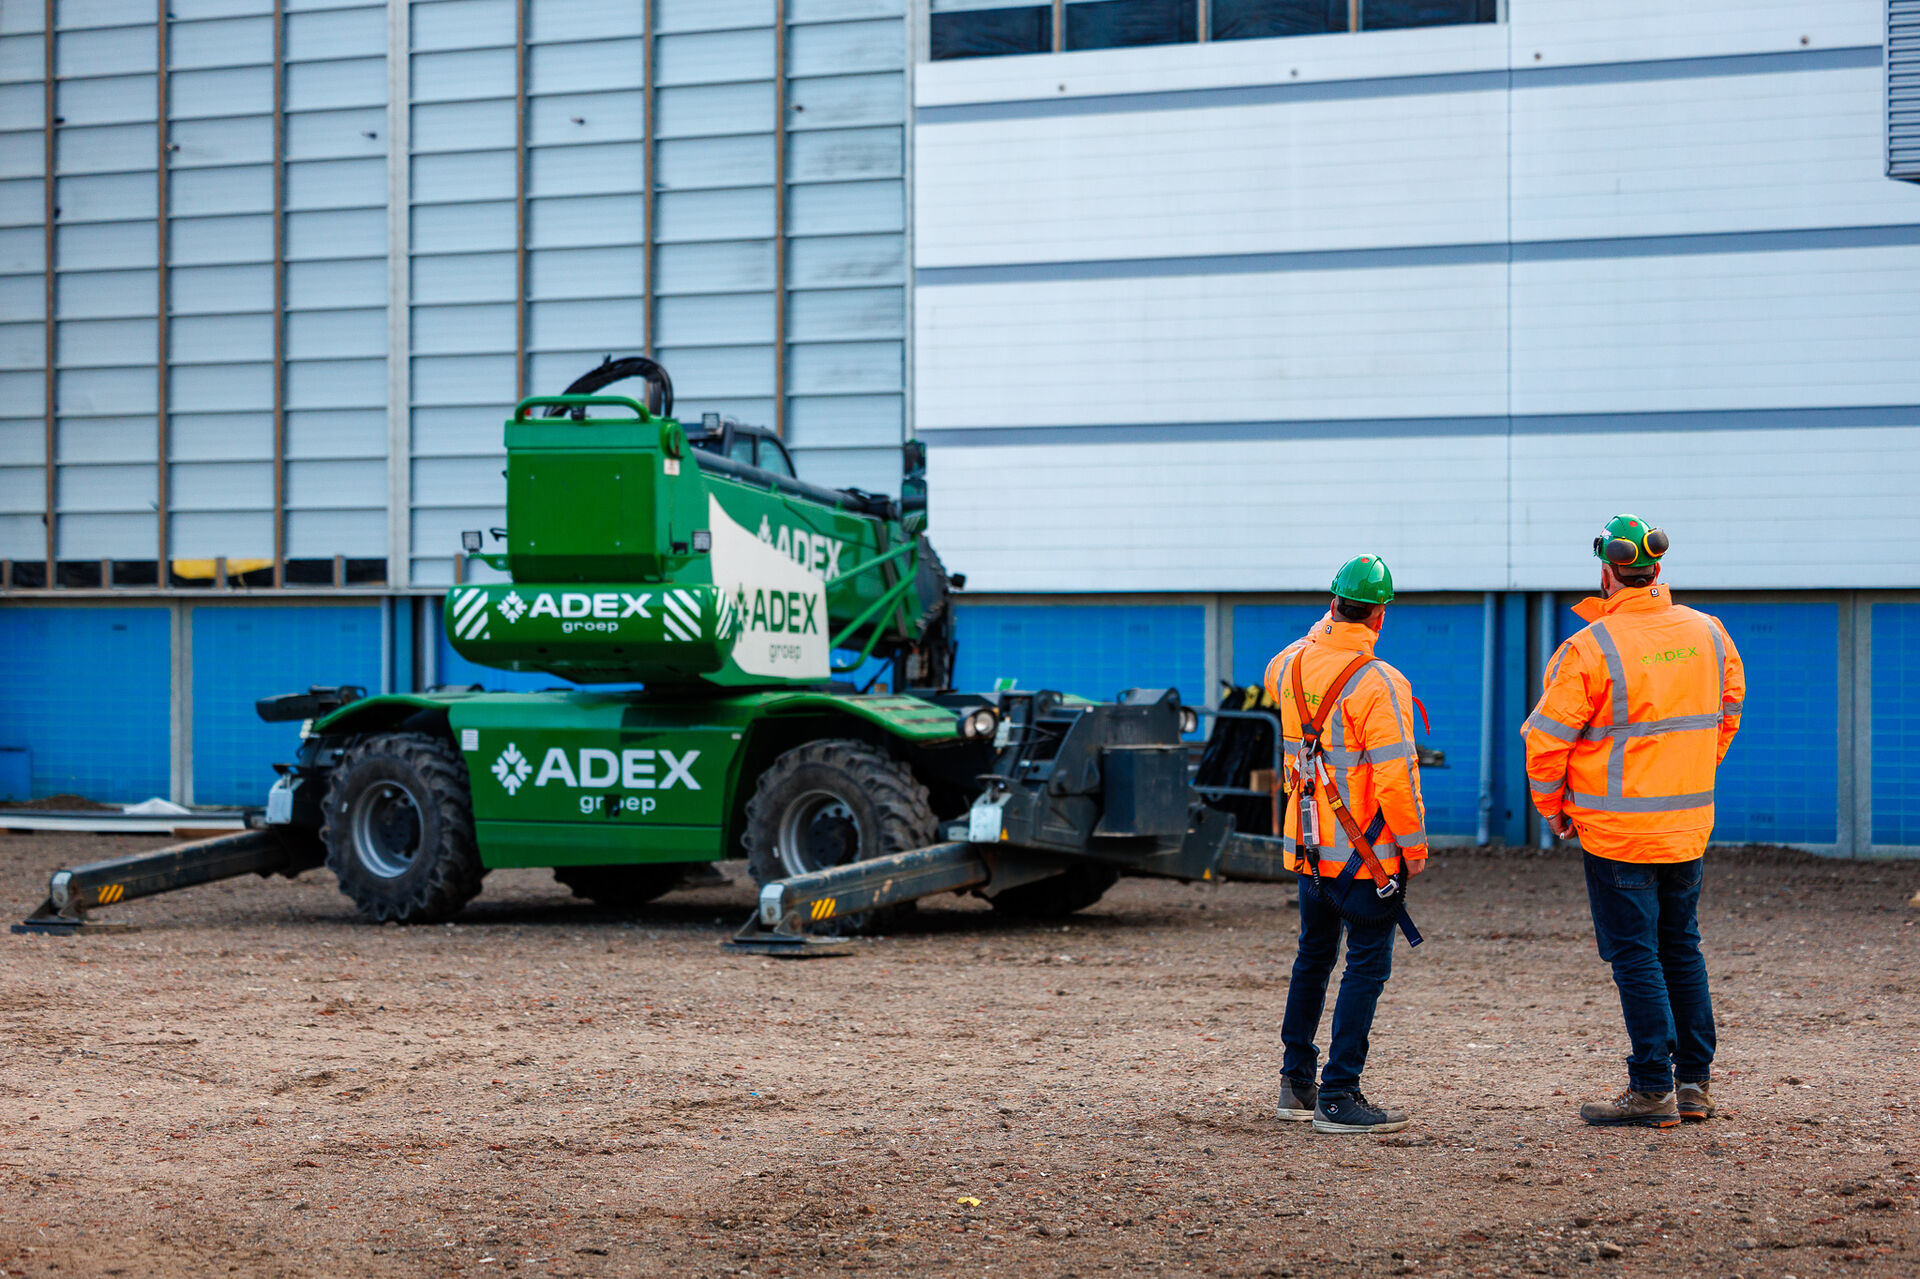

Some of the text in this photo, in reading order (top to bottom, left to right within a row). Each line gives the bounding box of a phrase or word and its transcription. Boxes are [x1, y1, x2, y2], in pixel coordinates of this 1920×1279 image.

[528, 593, 652, 618] ADEX
[751, 588, 818, 635] ADEX
[562, 621, 619, 633] groep
[769, 644, 801, 664] groep
[1654, 646, 1698, 663] ADEX
[534, 748, 702, 790] ADEX
[579, 795, 656, 815] grep
